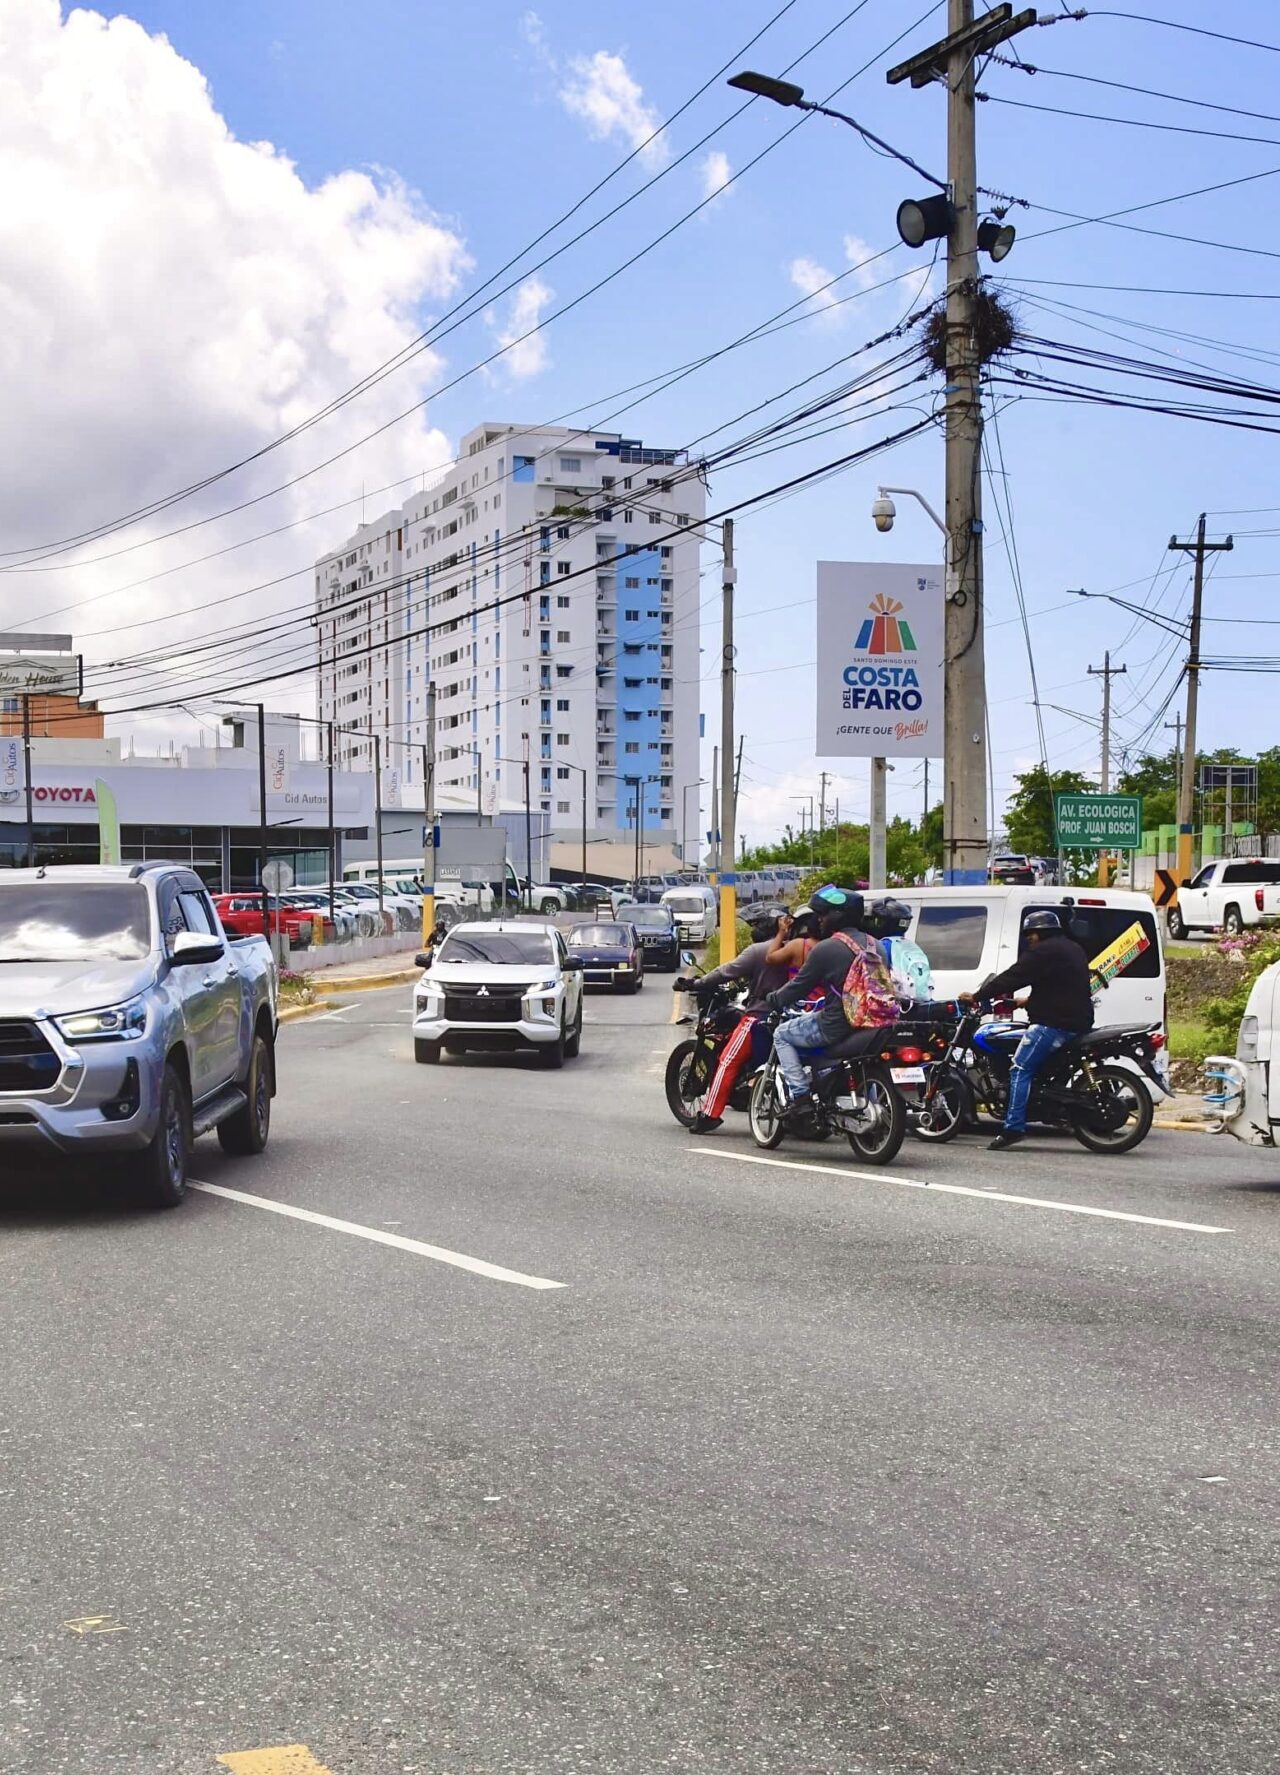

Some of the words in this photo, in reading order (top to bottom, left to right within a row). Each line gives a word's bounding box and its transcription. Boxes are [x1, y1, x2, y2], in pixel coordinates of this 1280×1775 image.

[843, 666, 919, 687] COSTA
[842, 688, 851, 709] DEL
[852, 688, 922, 711] FARO
[836, 725, 871, 735] ¡GENTE
[873, 726, 893, 735] QUE
[895, 719, 928, 740] Brilla!
[284, 793, 300, 804] Cid
[302, 793, 328, 804] Autos
[1060, 805, 1076, 817] AV.
[1078, 805, 1135, 819] ECOLOGICA
[1084, 822, 1107, 834] JUAN
[1108, 822, 1136, 835] BOSCH
